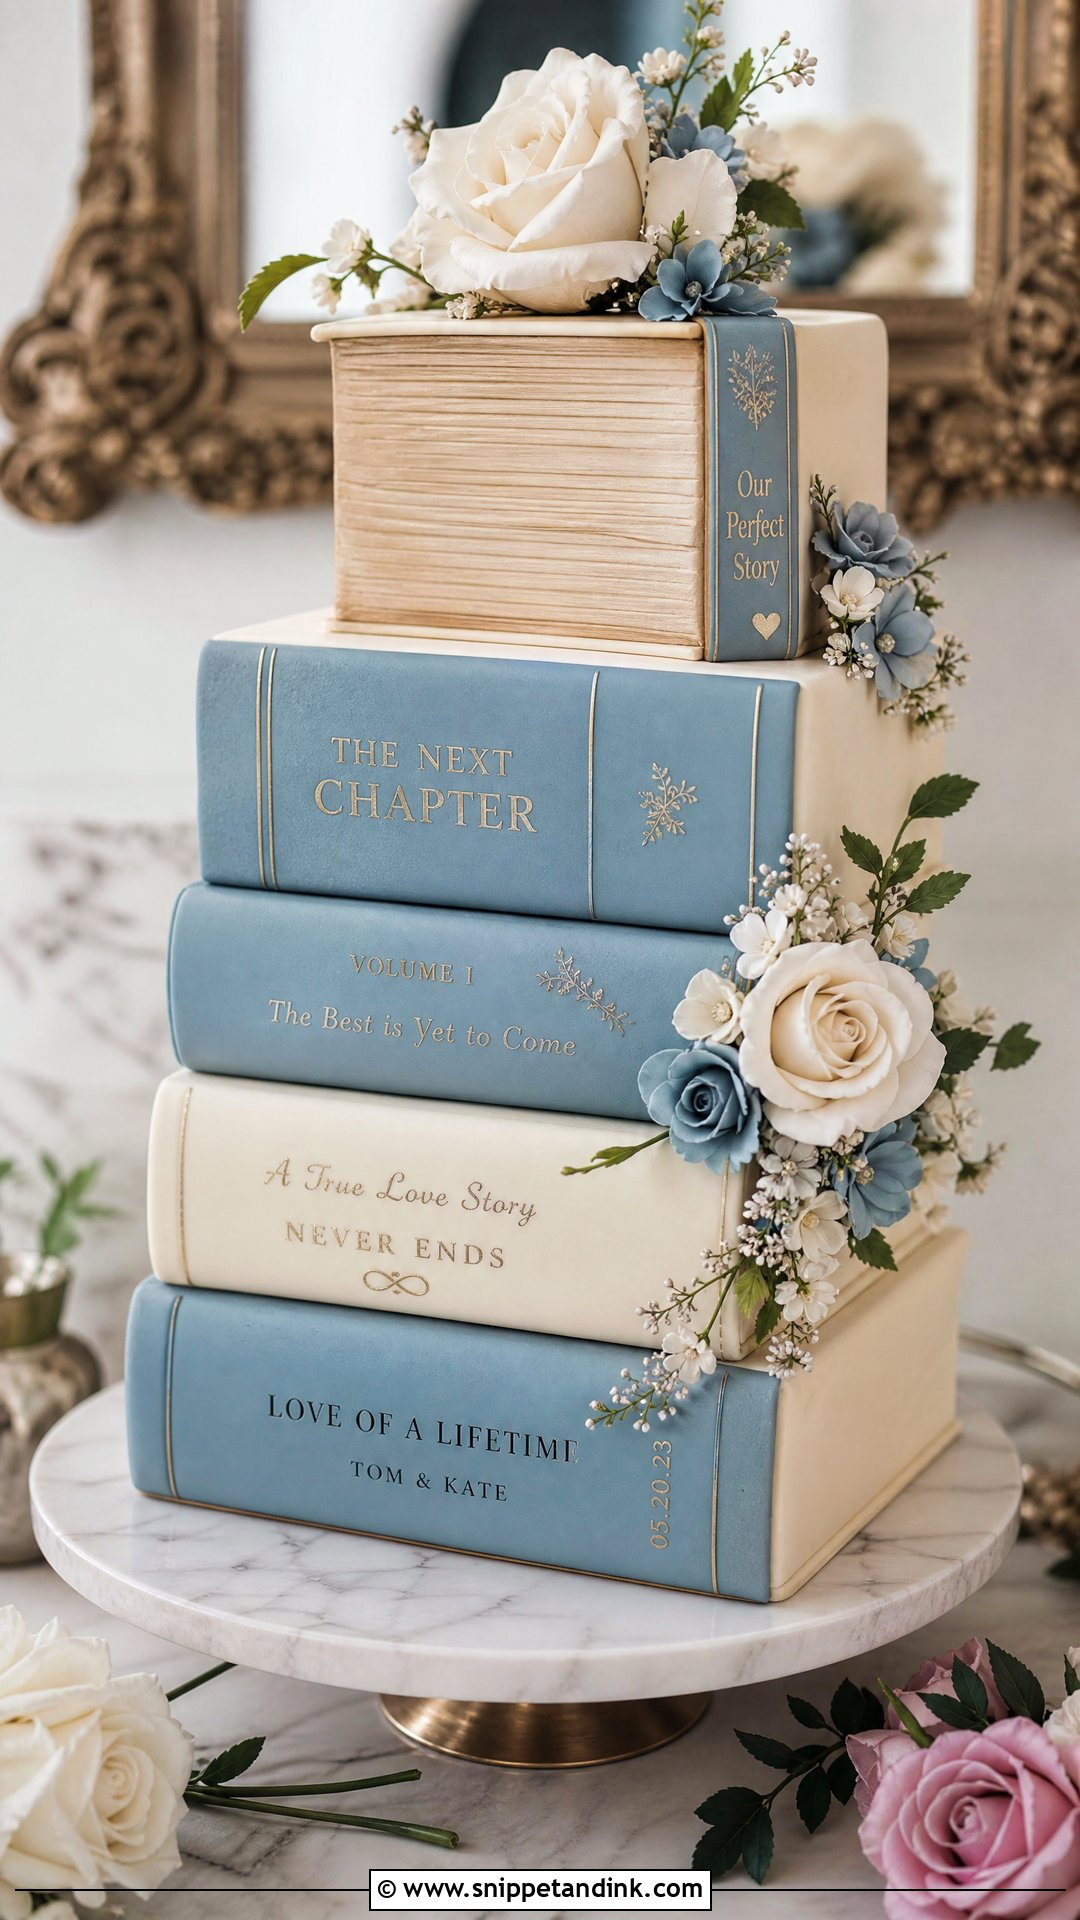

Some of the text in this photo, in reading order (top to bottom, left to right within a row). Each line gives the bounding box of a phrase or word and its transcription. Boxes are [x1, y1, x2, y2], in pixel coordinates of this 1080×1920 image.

[737, 470, 773, 498] Our
[726, 509, 784, 545] Perfect
[733, 552, 780, 586] Story
[331, 736, 513, 776] THE NEXT
[314, 779, 538, 833] CHAPTER
[350, 953, 473, 985] VOLUME I
[268, 999, 576, 1056] The Best is Yet to Come
[264, 1157, 536, 1227] A True Love Story
[285, 1220, 504, 1269] NEVER ENDS
[268, 1394, 342, 1428] LOVE
[355, 1409, 393, 1435] OF
[404, 1417, 423, 1441] A
[350, 1460, 508, 1502] TOM & KATE
[650, 1439, 673, 1550] 05.20.23
